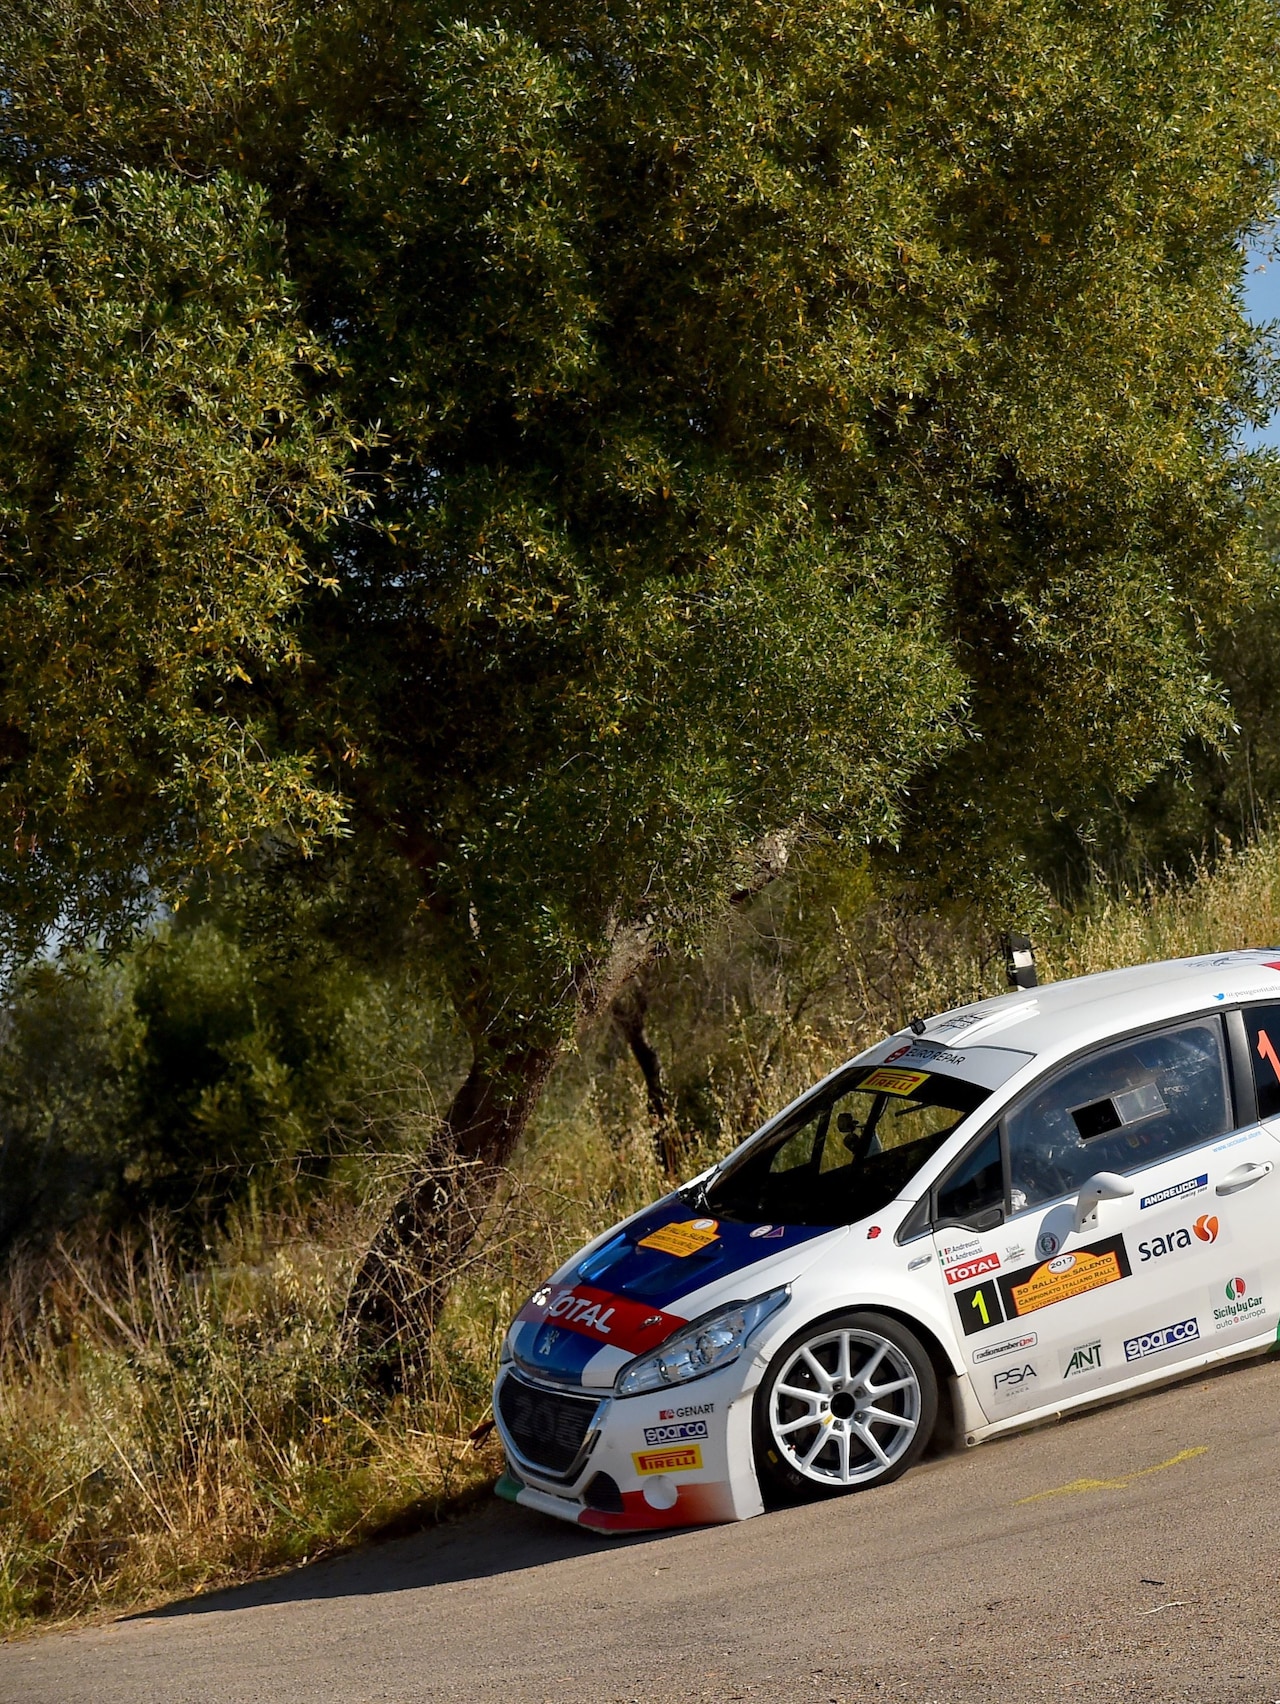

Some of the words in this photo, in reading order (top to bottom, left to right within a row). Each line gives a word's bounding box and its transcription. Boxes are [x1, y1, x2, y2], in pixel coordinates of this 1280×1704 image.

[866, 1072, 920, 1091] PIRELLI
[1144, 1179, 1198, 1207] ANDREUCCI
[948, 1238, 980, 1254] P.Andreucci
[950, 1247, 984, 1262] A.Andreussi
[1138, 1227, 1192, 1262] sara
[946, 1260, 1000, 1281] TOTAL
[1032, 1275, 1059, 1290] RALLY
[1072, 1257, 1112, 1275] SALENTO
[1049, 1256, 1074, 1269] 2017
[1018, 1286, 1061, 1306] CAMPIONATO
[1062, 1275, 1093, 1290] ITALIANO
[1094, 1266, 1116, 1278] RALLY
[543, 1288, 616, 1334] TOTAL
[971, 1289, 990, 1325] 1
[1216, 1318, 1233, 1330] auto
[1239, 1307, 1266, 1322] europa
[1126, 1320, 1198, 1358] sparco
[1063, 1344, 1102, 1379] ANT
[994, 1364, 1037, 1390] PSA
[676, 1403, 715, 1418] GENART
[645, 1422, 706, 1443] sparco
[637, 1449, 697, 1471] PIRELLI
